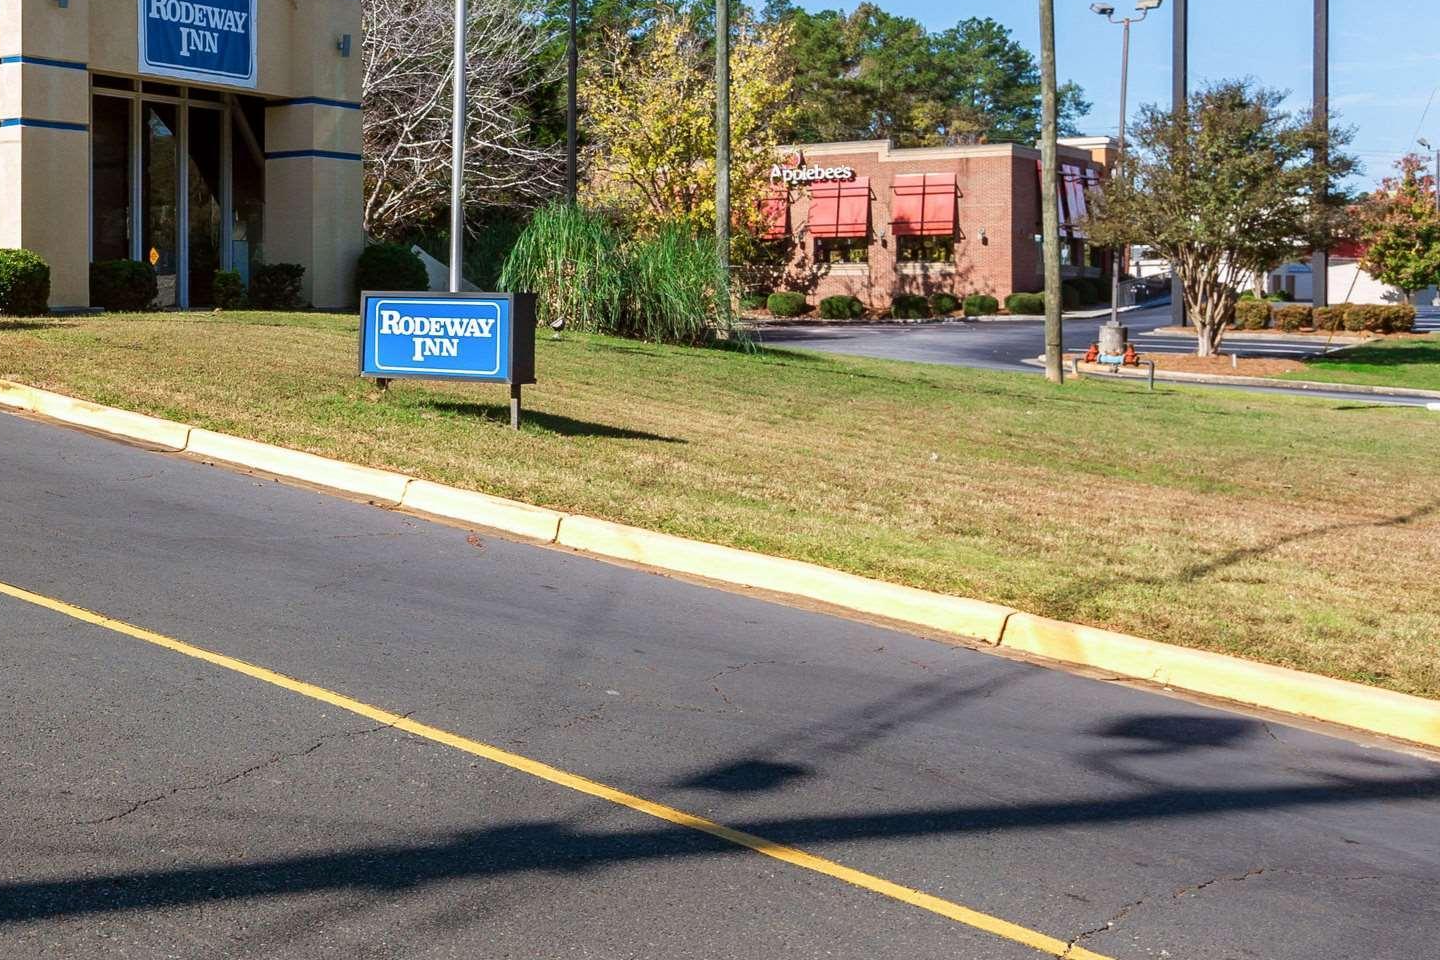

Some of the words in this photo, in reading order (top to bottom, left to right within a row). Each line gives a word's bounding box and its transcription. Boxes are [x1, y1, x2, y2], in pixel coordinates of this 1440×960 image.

[179, 26, 219, 57] INN
[380, 310, 495, 338] RODEWAY
[412, 337, 459, 361] INN
